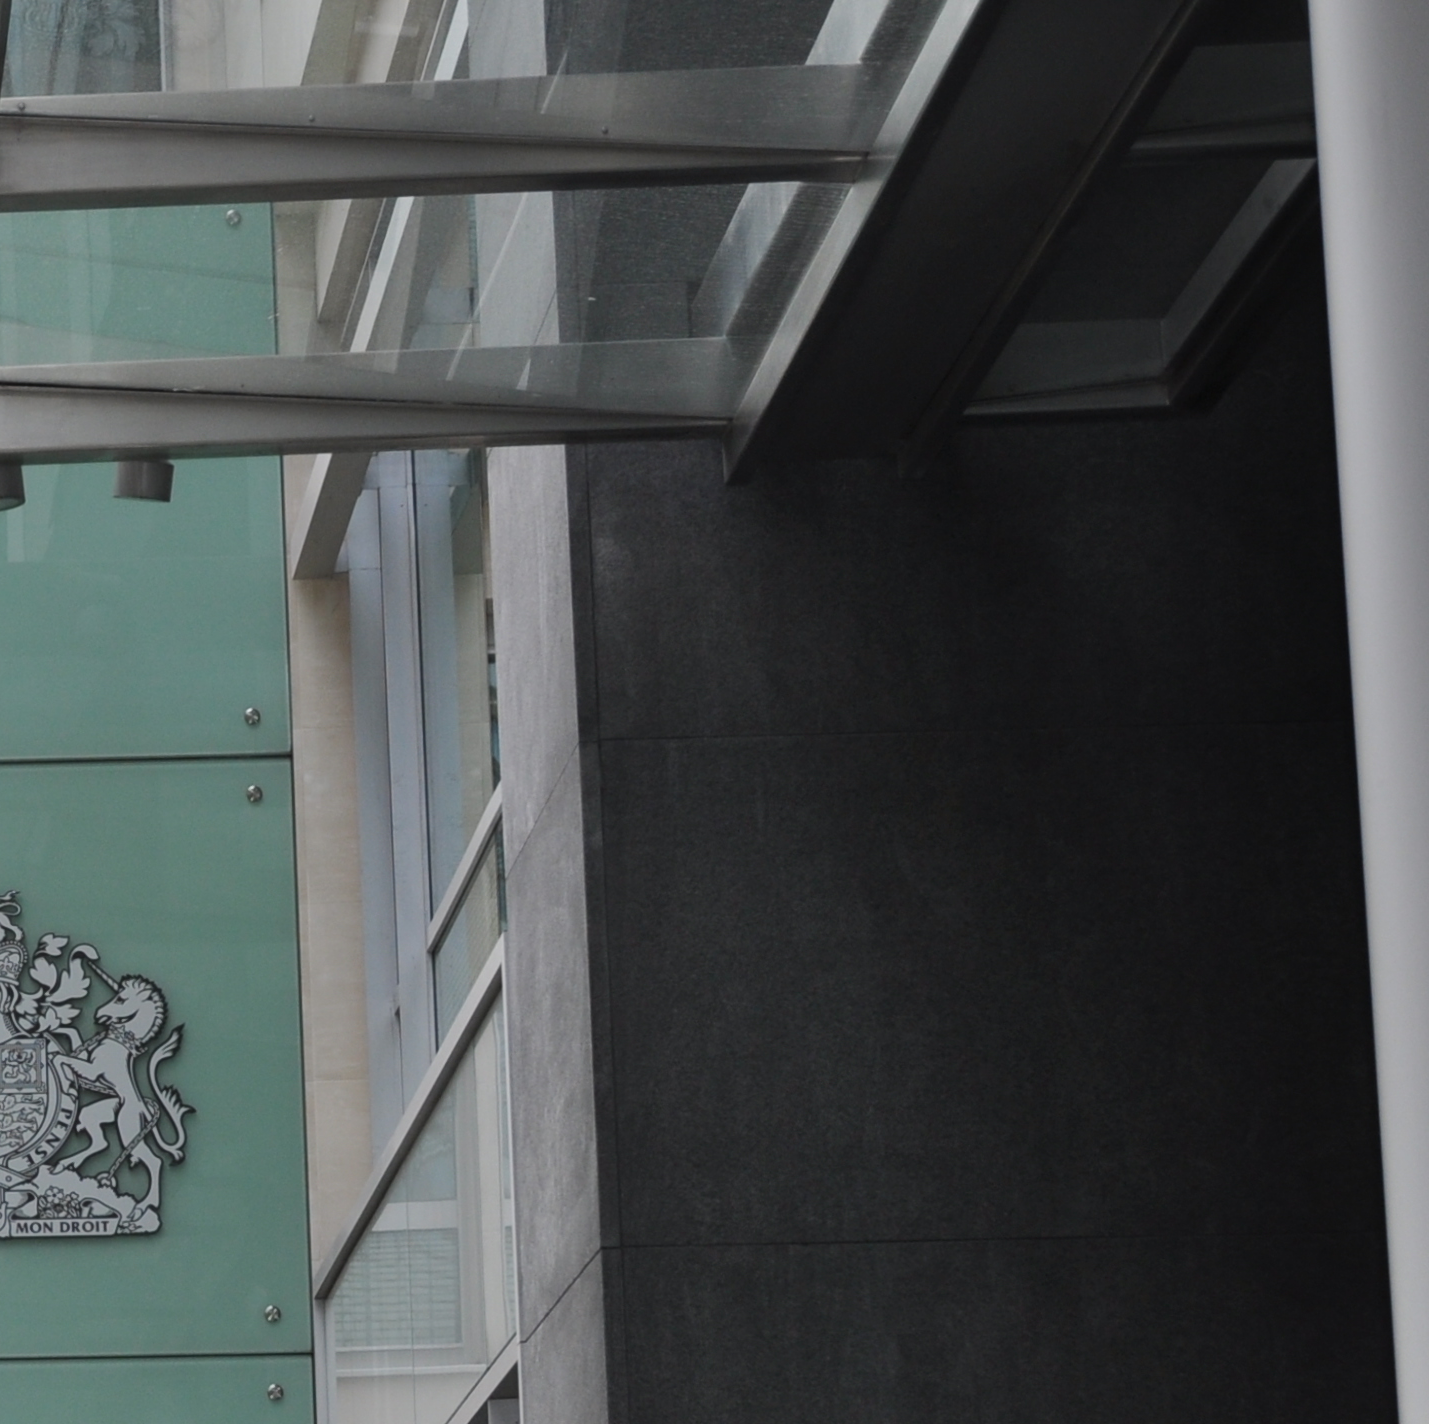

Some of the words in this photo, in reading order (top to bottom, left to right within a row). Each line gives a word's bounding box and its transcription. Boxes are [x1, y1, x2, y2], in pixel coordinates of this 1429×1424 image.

[23, 1107, 73, 1167] PENSE
[16, 1222, 54, 1234] MON
[60, 1221, 110, 1233] DROIT
